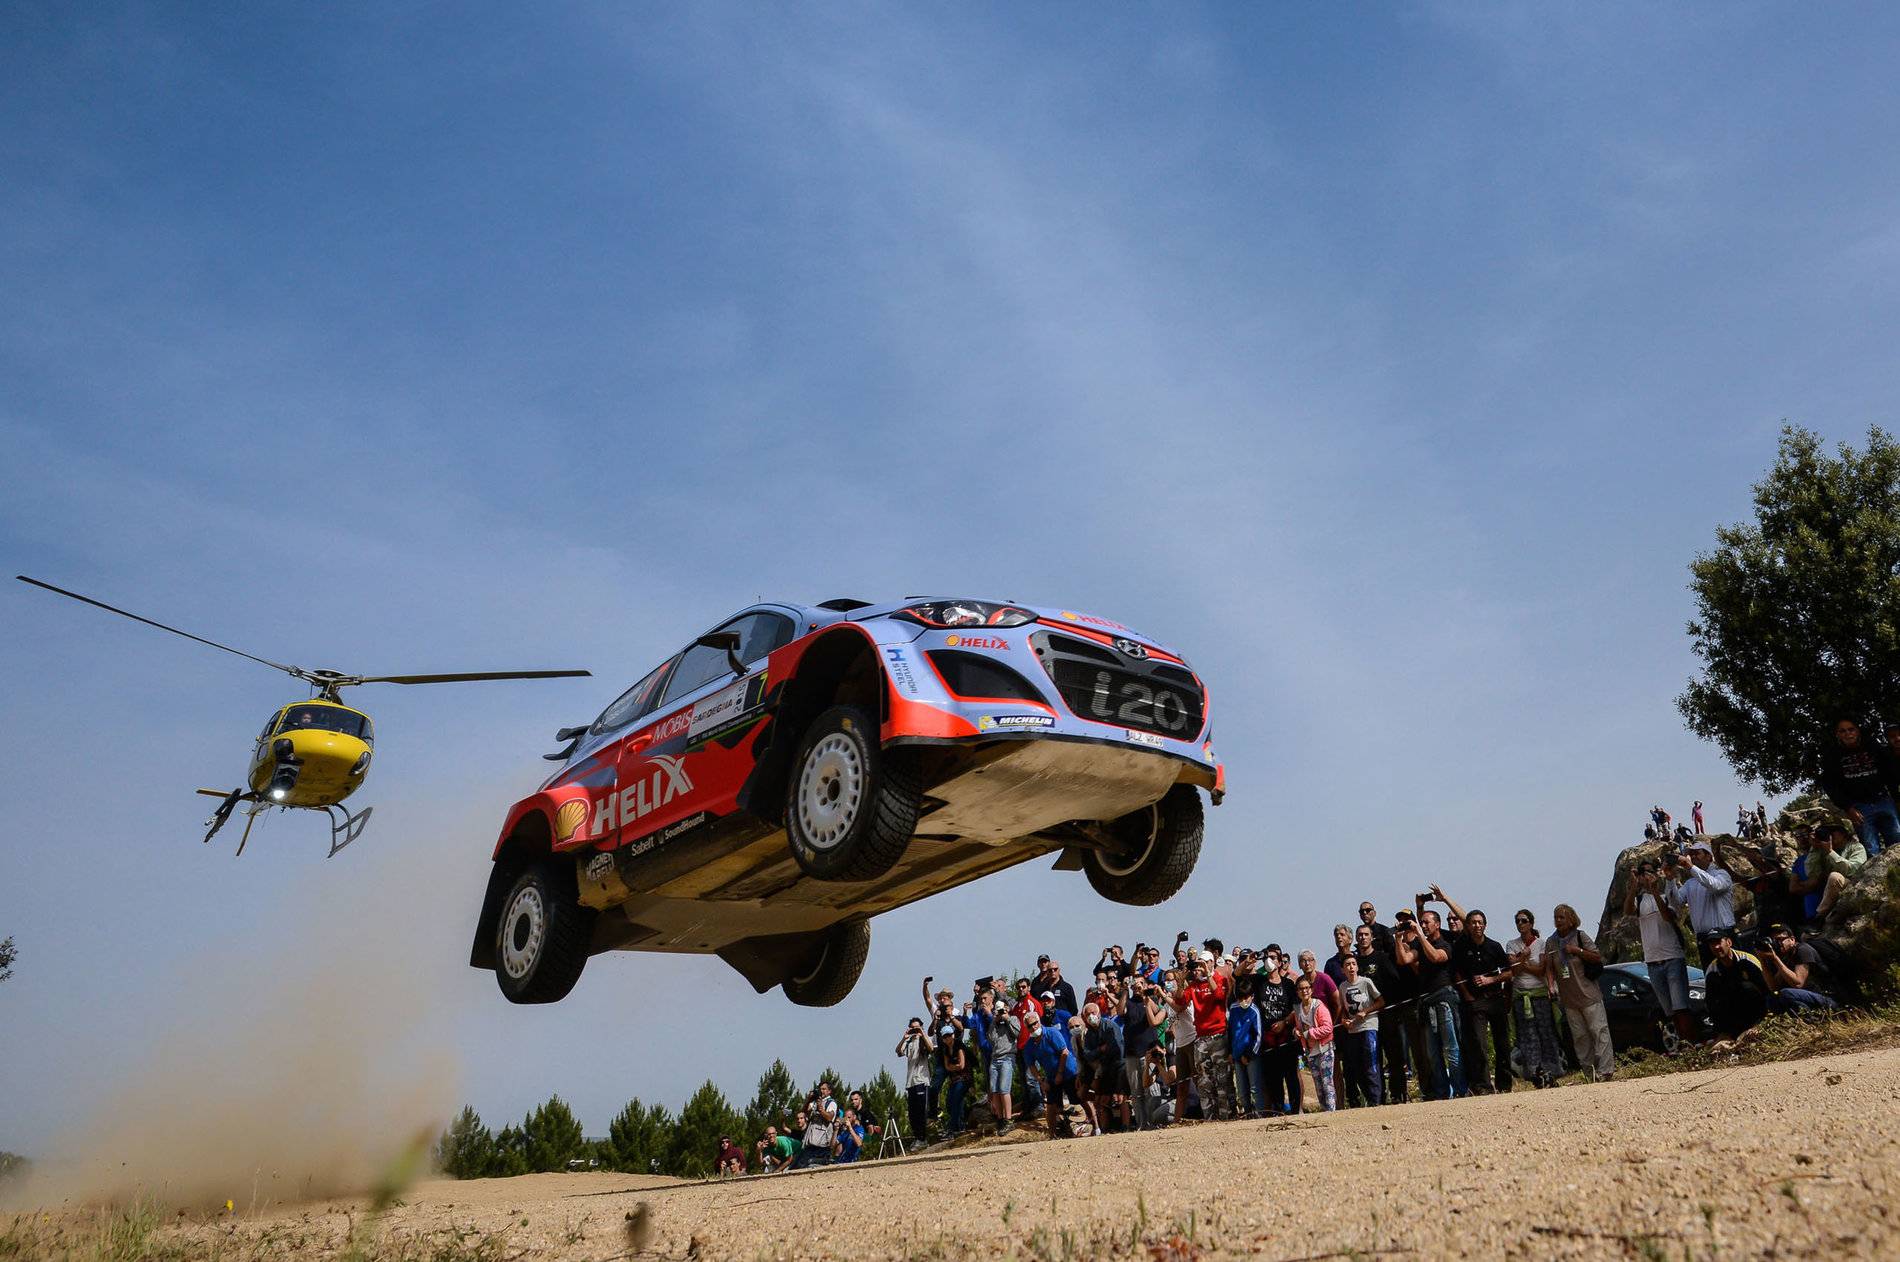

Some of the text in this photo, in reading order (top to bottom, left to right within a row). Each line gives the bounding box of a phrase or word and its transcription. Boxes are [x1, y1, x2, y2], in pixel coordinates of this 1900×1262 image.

[960, 635, 1011, 650] HELIX
[892, 662, 906, 686] STEEL
[901, 662, 919, 694] HYUNDAI
[1090, 671, 1187, 731] i20
[652, 709, 694, 743] MOBIS
[999, 716, 1053, 725] MICHELIN
[590, 754, 694, 836] HELIX
[631, 836, 655, 857] Sabelt
